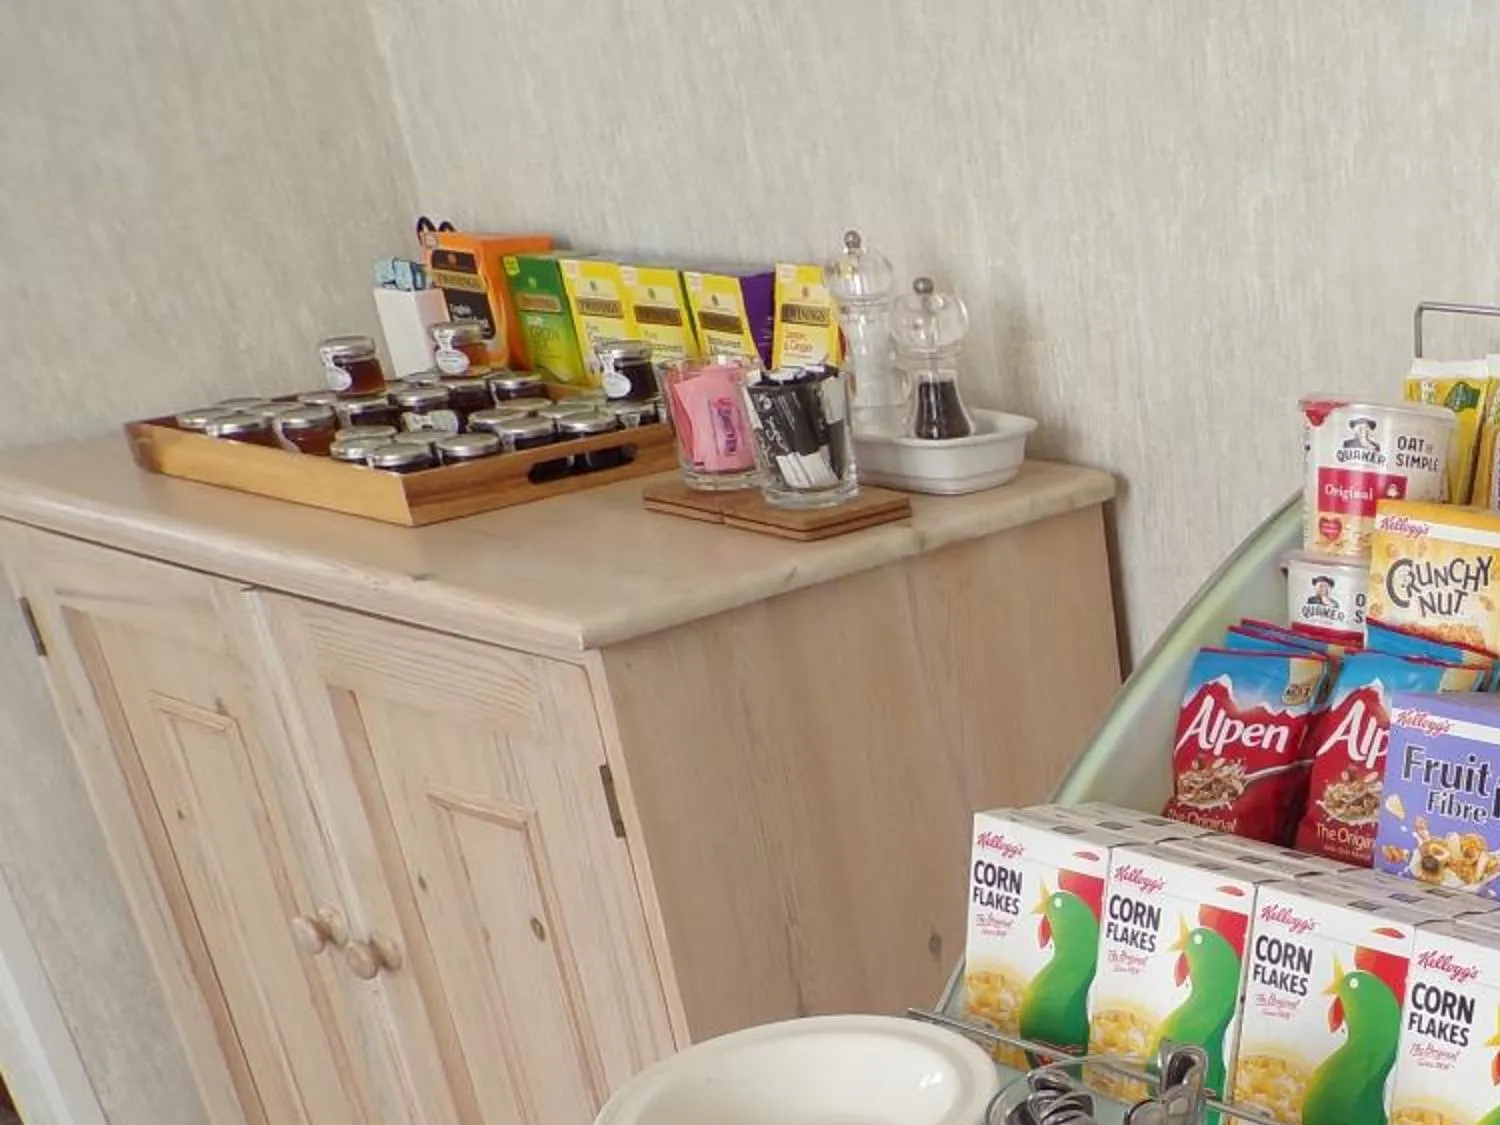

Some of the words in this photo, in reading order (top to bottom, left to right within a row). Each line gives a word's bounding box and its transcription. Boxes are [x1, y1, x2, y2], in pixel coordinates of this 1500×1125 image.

[1336, 449, 1387, 464] QUAKER
[1397, 435, 1425, 451] OAT
[1395, 454, 1440, 473] SIMPLE
[1324, 483, 1373, 501] Original
[1379, 515, 1430, 538] Kellogg's
[1386, 555, 1494, 608] CRUNCHY
[1418, 589, 1468, 617] NUT
[1174, 694, 1289, 756] Alpen
[1316, 700, 1390, 768] Alp
[1397, 706, 1453, 736] Kellogg's
[1402, 744, 1490, 798] Fruit
[1426, 789, 1489, 822] Fibre
[977, 831, 1025, 859] Kellogg's
[1316, 823, 1336, 841] The
[974, 860, 1023, 895] CORN
[1114, 864, 1166, 893] Kellogg's
[973, 887, 1020, 916] FLAKES
[1109, 894, 1162, 931] CORN
[1260, 903, 1316, 934] Kellogg's
[1106, 922, 1157, 952] FLAKES
[1255, 934, 1313, 975] CORN
[1418, 949, 1481, 983] Kellogg's
[1253, 963, 1309, 997] FLAKES
[1411, 982, 1475, 1025] CORN
[1408, 1012, 1470, 1048] FLAKES
